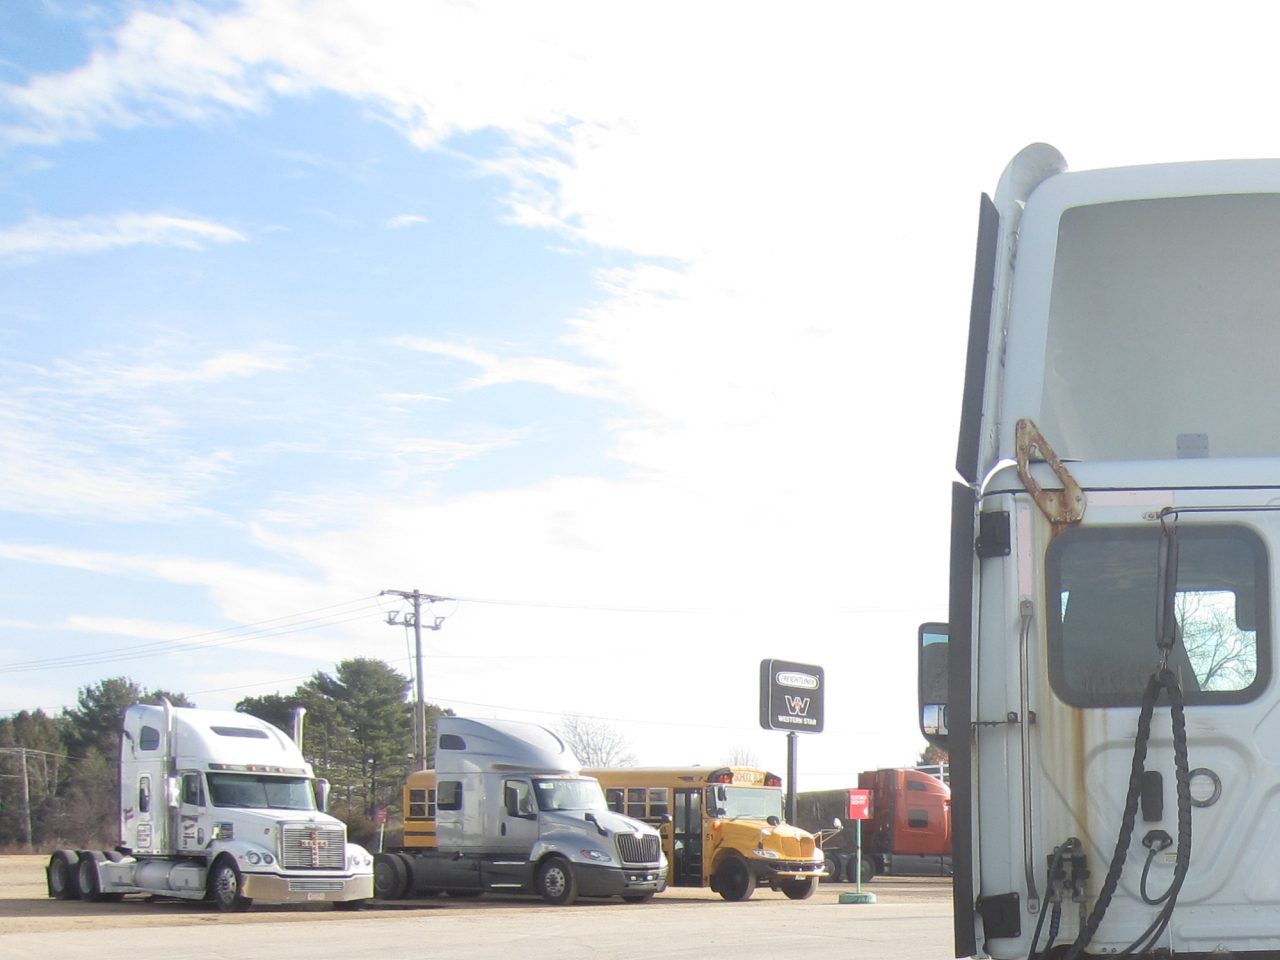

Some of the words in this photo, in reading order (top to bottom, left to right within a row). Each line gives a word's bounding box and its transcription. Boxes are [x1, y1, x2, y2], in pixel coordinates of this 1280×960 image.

[778, 715, 803, 725] WESTERN
[803, 717, 817, 726] STAR
[733, 771, 752, 783] SCHOOL
